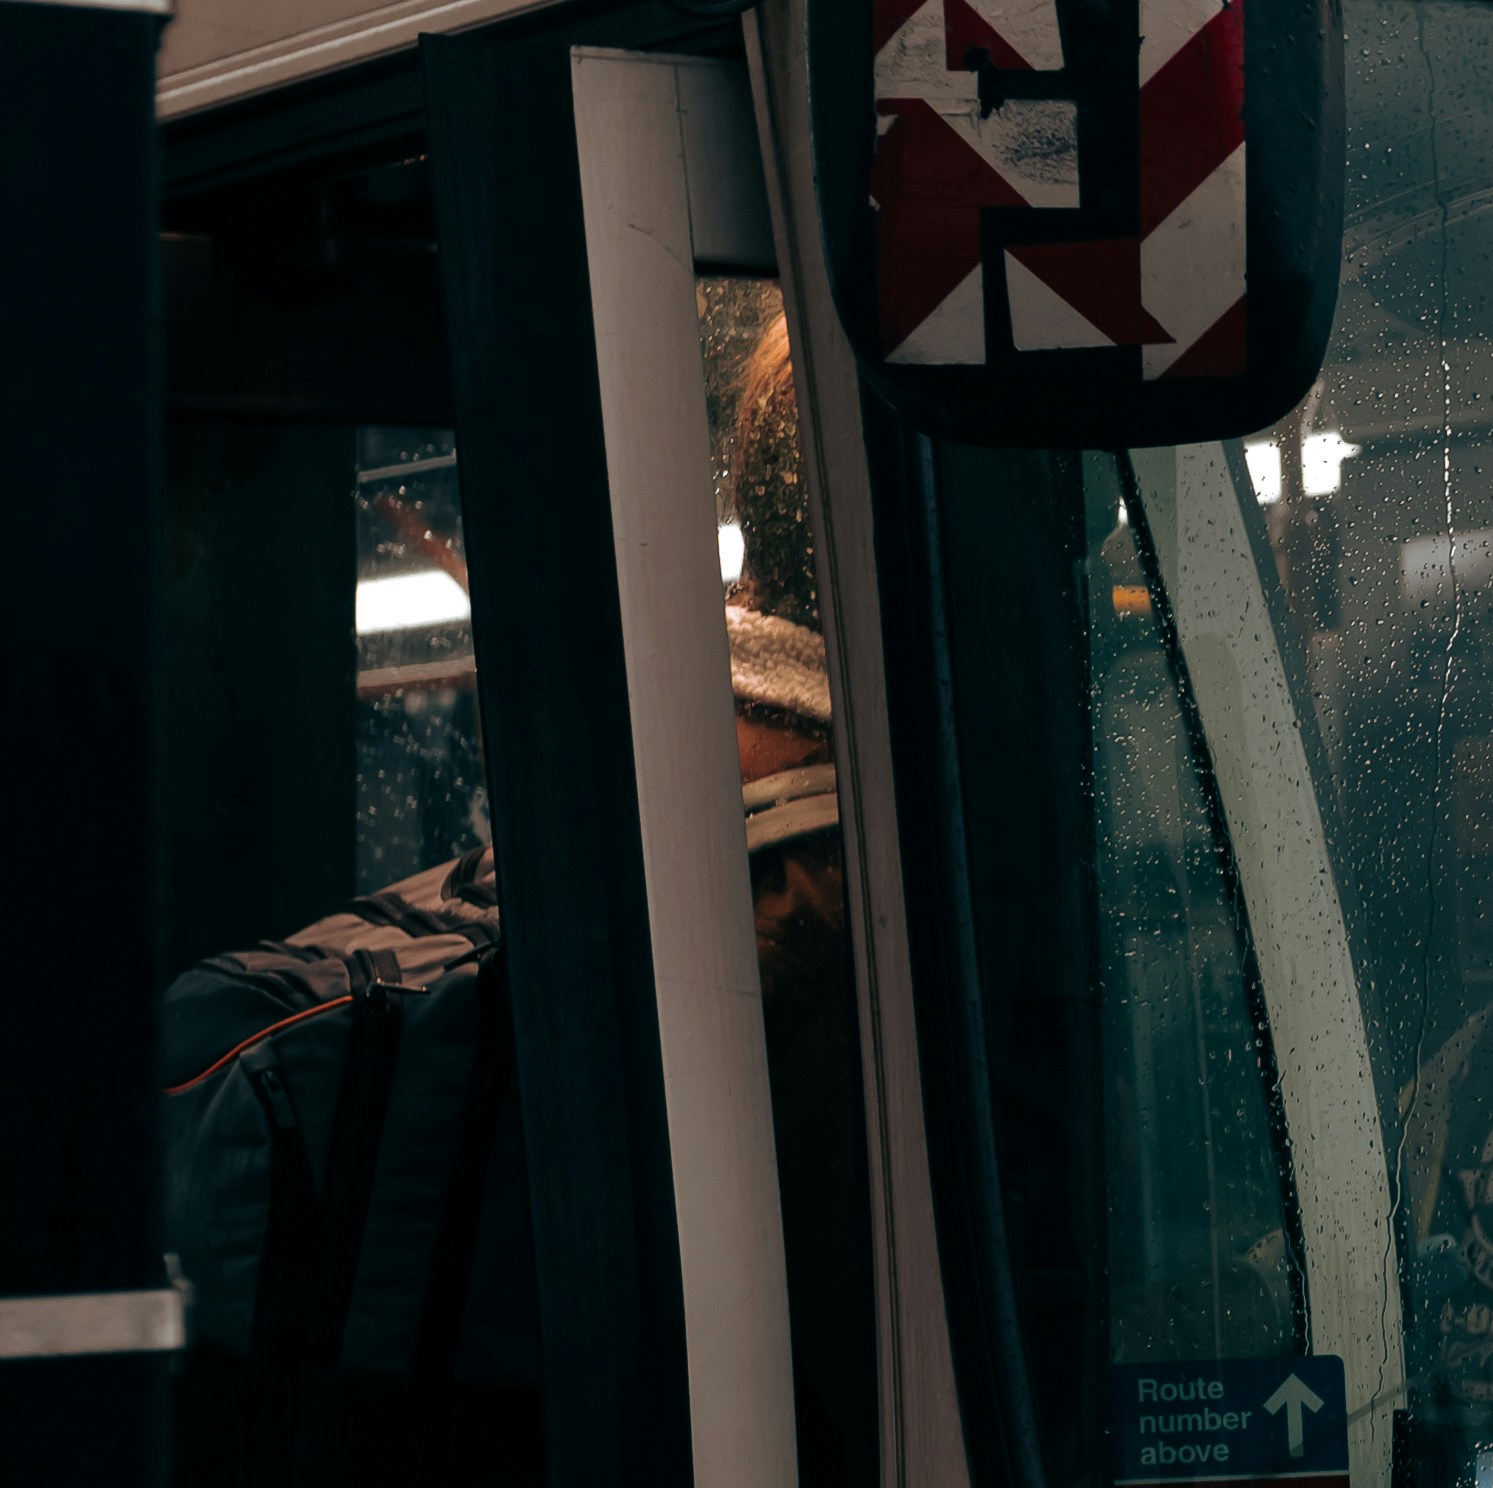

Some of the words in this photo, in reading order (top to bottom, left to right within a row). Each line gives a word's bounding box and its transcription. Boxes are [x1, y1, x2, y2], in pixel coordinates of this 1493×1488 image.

[1138, 1378, 1224, 1402] Route
[1140, 1407, 1252, 1434] number
[1141, 1440, 1230, 1465] above
